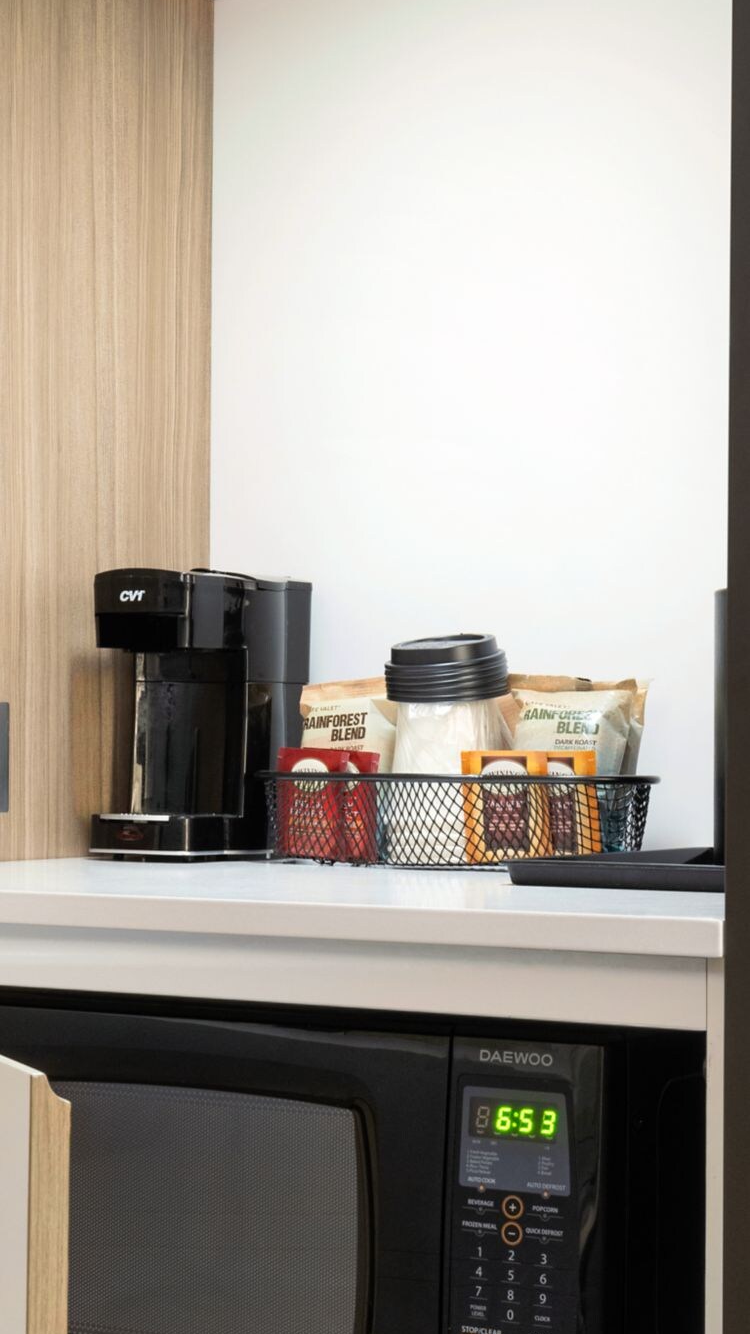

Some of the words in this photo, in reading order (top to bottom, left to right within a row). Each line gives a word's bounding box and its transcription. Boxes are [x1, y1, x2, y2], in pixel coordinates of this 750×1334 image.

[524, 708, 598, 721] RAINFORES
[304, 712, 368, 730] RAINFOREST
[557, 721, 600, 735] BLEND
[331, 727, 366, 742] BLEND
[480, 1049, 553, 1066] DAEWOO
[496, 1106, 556, 1135] 6:53
[467, 1175, 481, 1183] AUTO
[481, 1177, 496, 1185] COOK
[527, 1181, 541, 1189] AUTO
[542, 1182, 567, 1192] DEFROST
[467, 1198, 494, 1207] BEVERAGE
[532, 1205, 558, 1213] POPCORN
[462, 1220, 481, 1228] FROZEN
[482, 1222, 497, 1230] MEAL
[525, 1227, 540, 1235] QUICK
[541, 1228, 564, 1237] DEFROST
[508, 1250, 515, 1261] 2
[540, 1253, 547, 1265] 3
[475, 1266, 482, 1277] 4
[507, 1270, 514, 1281] 5
[540, 1273, 547, 1285] 6
[475, 1286, 482, 1297] 7
[507, 1289, 514, 1301] 8
[539, 1293, 547, 1304] 9
[506, 1309, 514, 1320] 0
